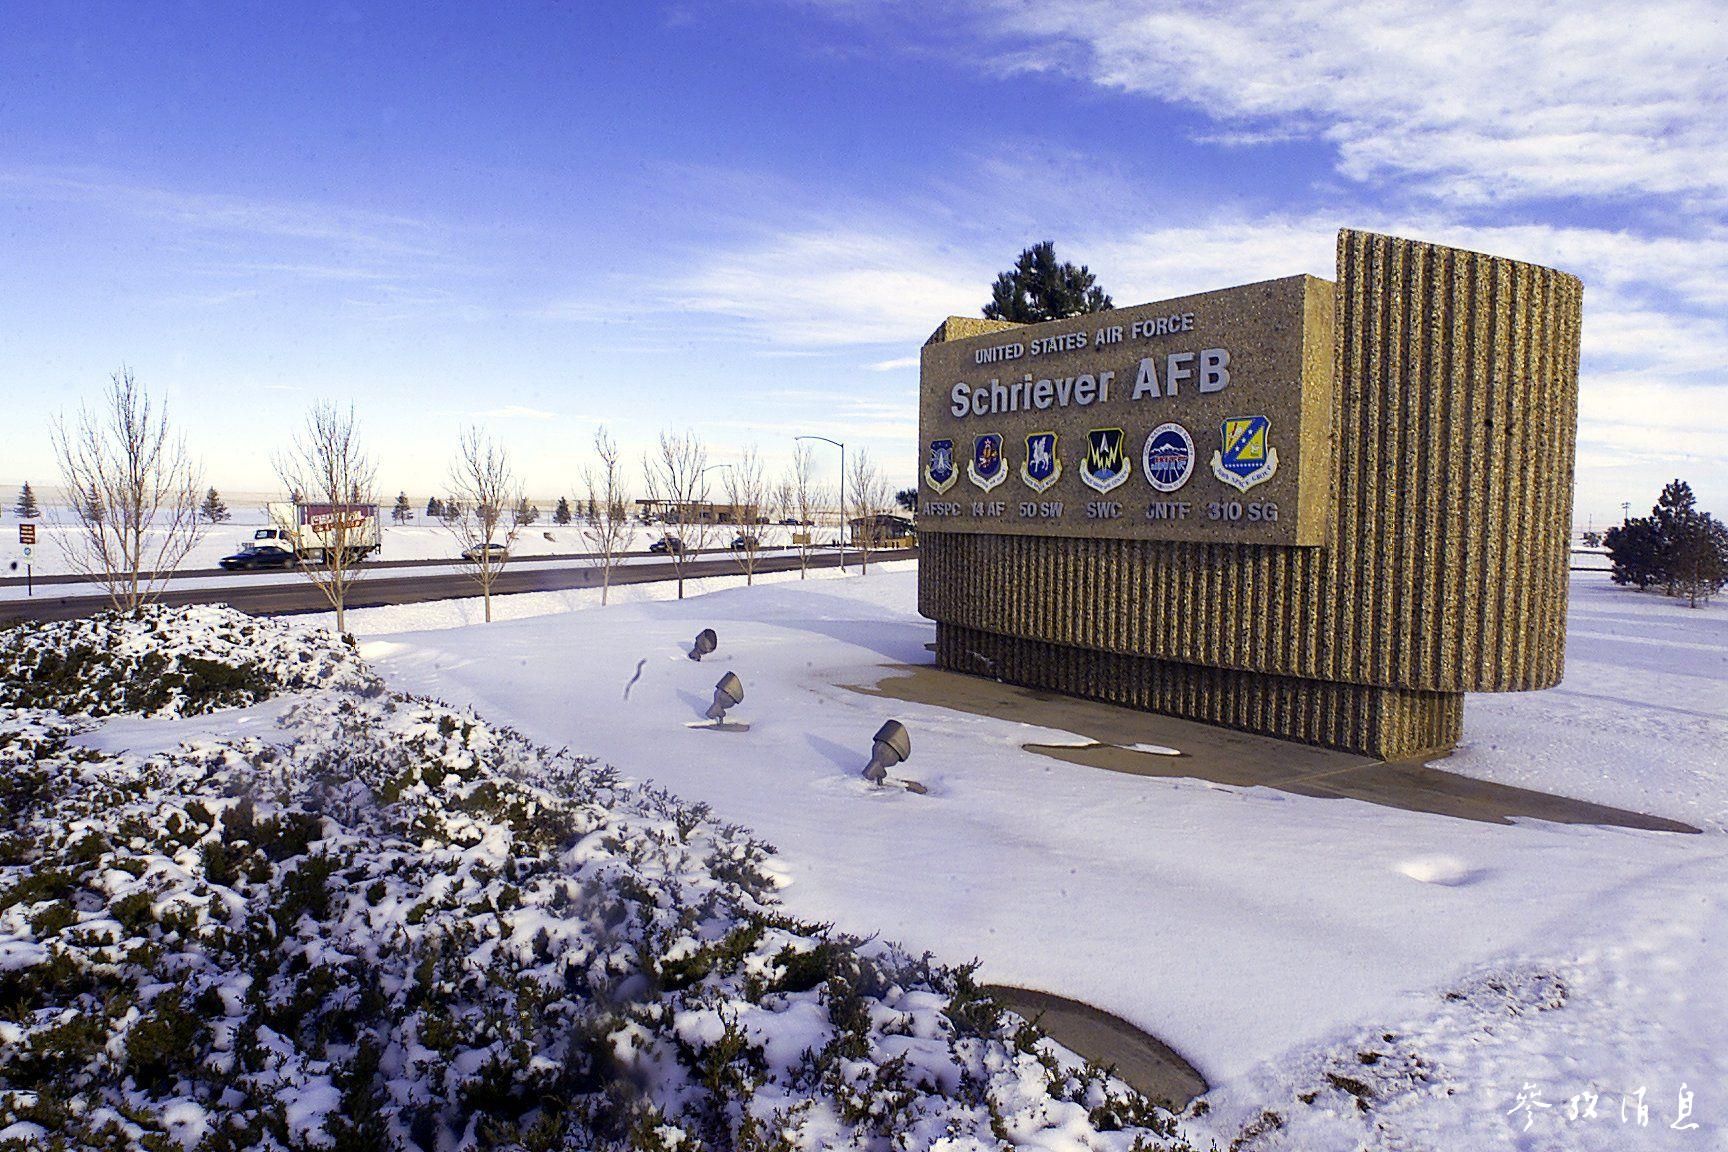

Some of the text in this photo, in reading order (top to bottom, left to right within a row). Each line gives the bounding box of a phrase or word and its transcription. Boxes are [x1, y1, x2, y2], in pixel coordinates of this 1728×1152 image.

[975, 313, 1195, 364] UNITED STATES AIR FORCE
[950, 348, 1231, 418] Schriever AFB
[922, 501, 961, 516] AFSPC
[970, 501, 1006, 516] 14 AF
[1019, 502, 1064, 518] 50 SW
[1086, 502, 1123, 519] SWC
[1145, 502, 1192, 520] JNTF
[1207, 502, 1279, 521] 310 SG
